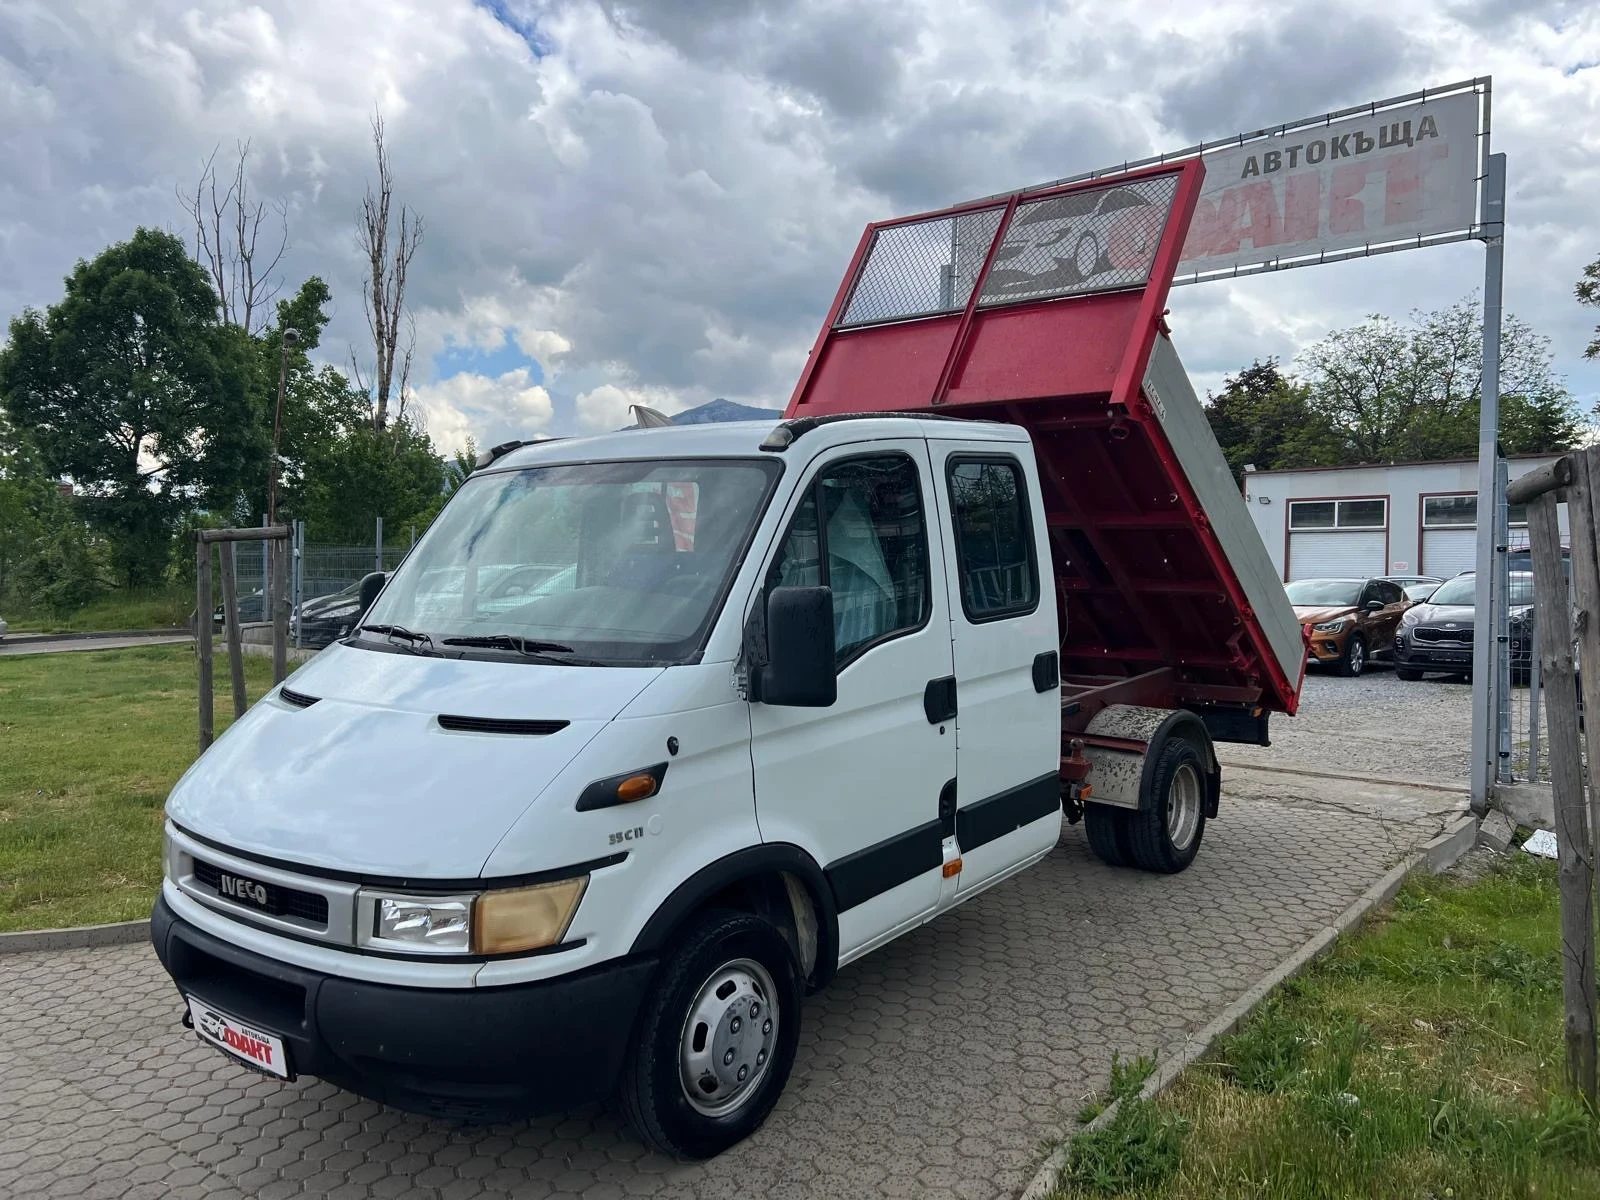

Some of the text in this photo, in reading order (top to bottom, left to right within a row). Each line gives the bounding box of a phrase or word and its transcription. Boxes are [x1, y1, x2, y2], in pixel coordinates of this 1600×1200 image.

[1241, 114, 1438, 178] АВТОКЪЩА
[221, 875, 267, 904] IVECO
[223, 1026, 272, 1065] ФАКТ
